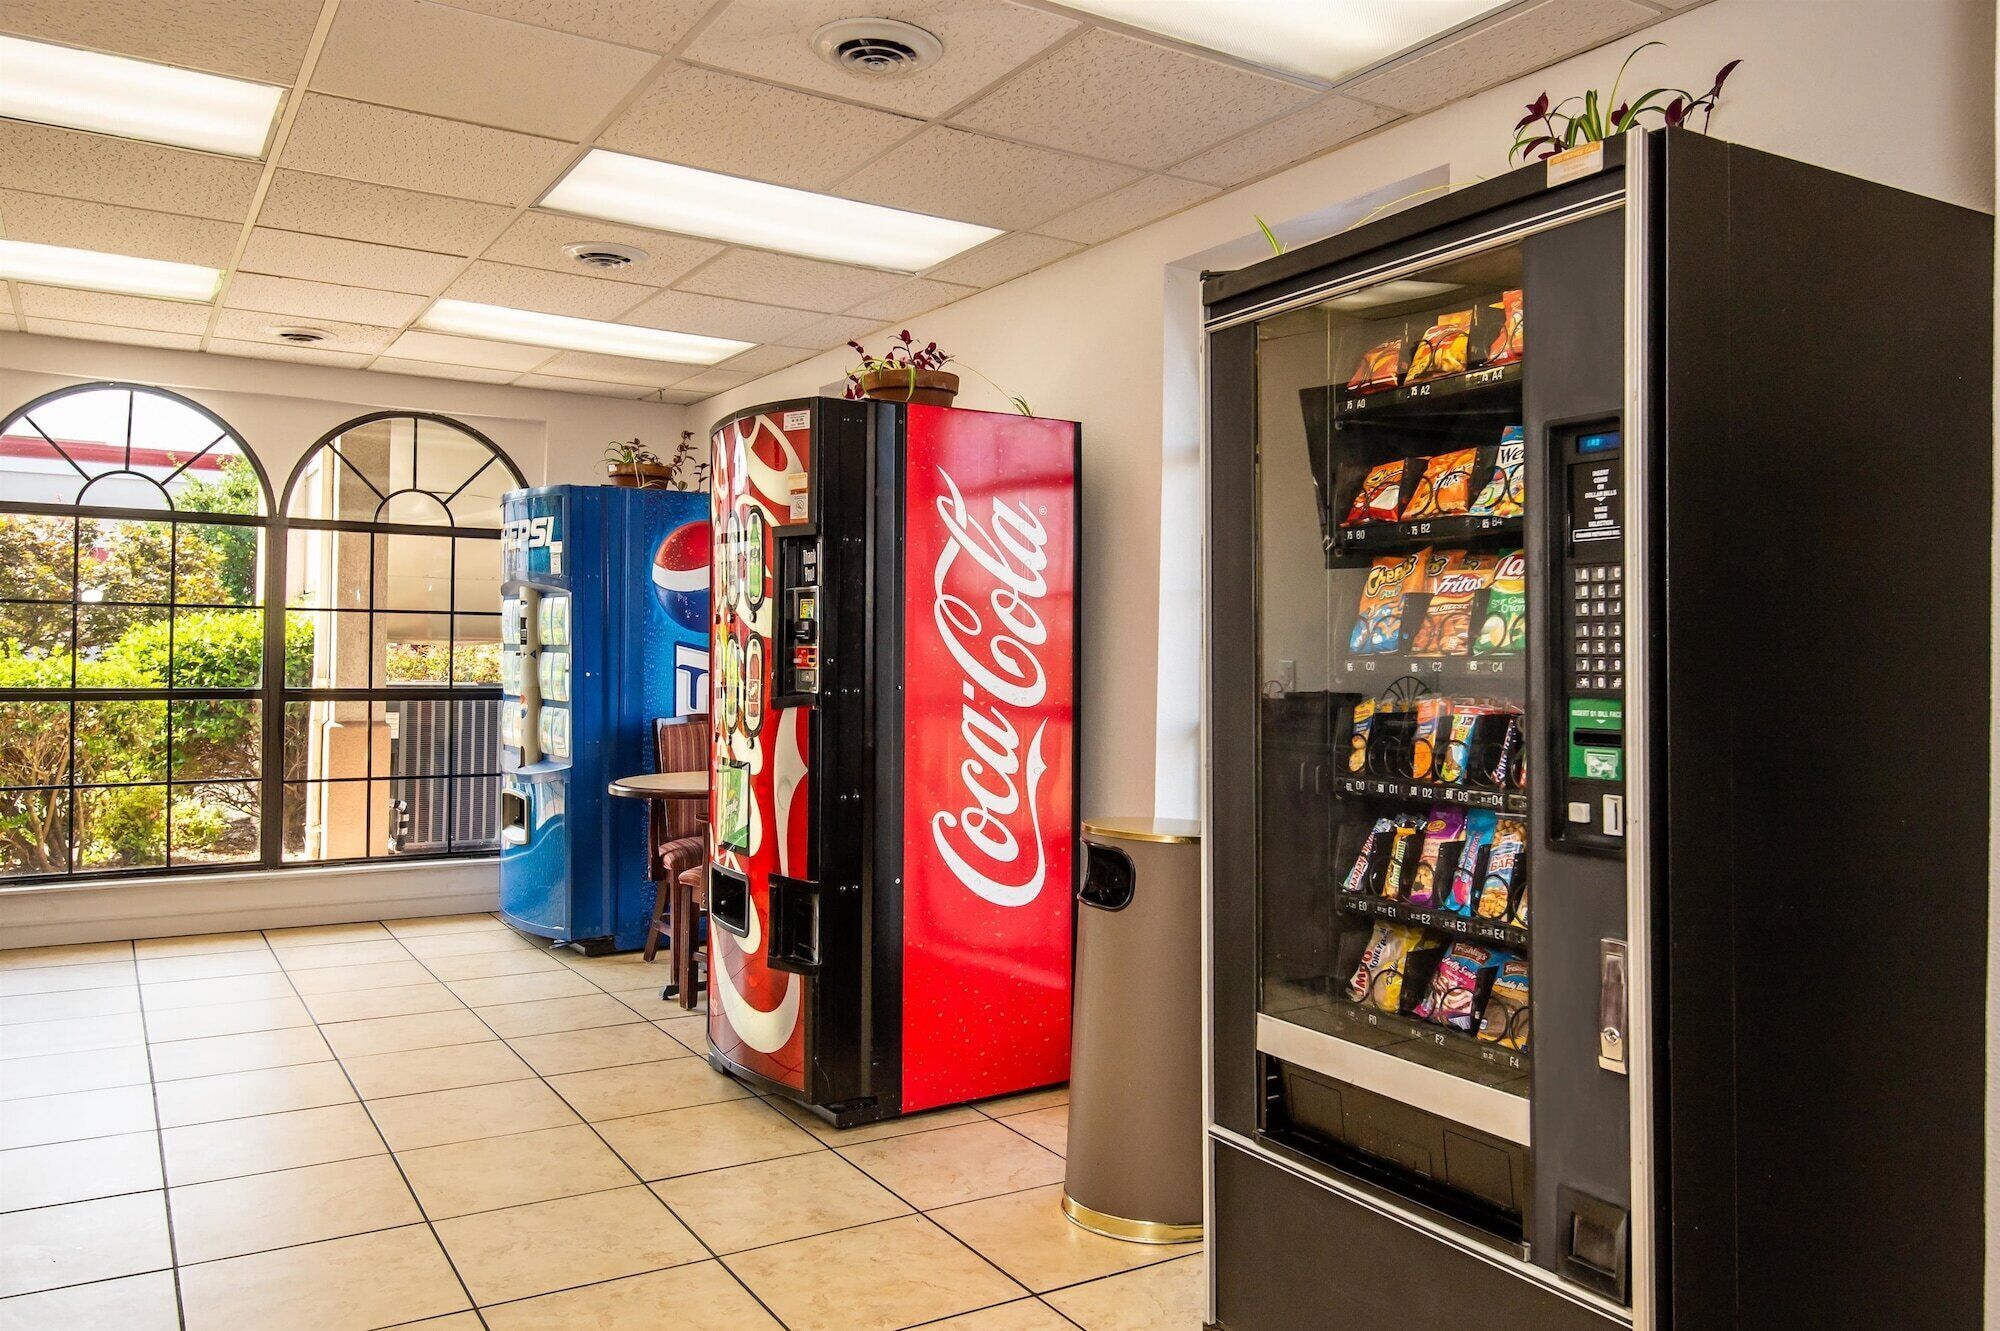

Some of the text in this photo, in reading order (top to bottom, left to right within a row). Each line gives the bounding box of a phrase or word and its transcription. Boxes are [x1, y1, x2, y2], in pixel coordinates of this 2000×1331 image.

[1492, 370, 1503, 381] A4
[1420, 384, 1431, 396] A2
[1356, 398, 1366, 409] A0
[1501, 447, 1524, 464] We
[1420, 523, 1430, 533] B2
[1492, 518, 1502, 527] B4
[501, 517, 555, 549] PEPSI
[1356, 530, 1365, 539] B0
[1496, 555, 1524, 580] La
[1614, 567, 1620, 577] C
[1439, 574, 1485, 594] Fritos
[1598, 586, 1604, 595] E
[1614, 585, 1620, 595] F
[1582, 602, 1620, 613] G H J
[1598, 626, 1603, 635] 2
[1614, 626, 1620, 635] 3
[1581, 643, 1620, 652] 4 5 6
[1366, 662, 1375, 671] C0
[1432, 662, 1442, 671] C2
[1492, 662, 1502, 672] C4
[1598, 660, 1603, 670] 8
[1614, 660, 1620, 670] 9
[932, 464, 1048, 907] Coca-Cola
[1358, 901, 1367, 912] E0
[1388, 907, 1396, 918] E1
[1421, 913, 1431, 925] E2
[1457, 921, 1467, 932] E3
[1494, 928, 1505, 940] E4
[1368, 1015, 1377, 1025] F0
[1435, 1034, 1445, 1046] F2
[1509, 1056, 1519, 1069] F4
